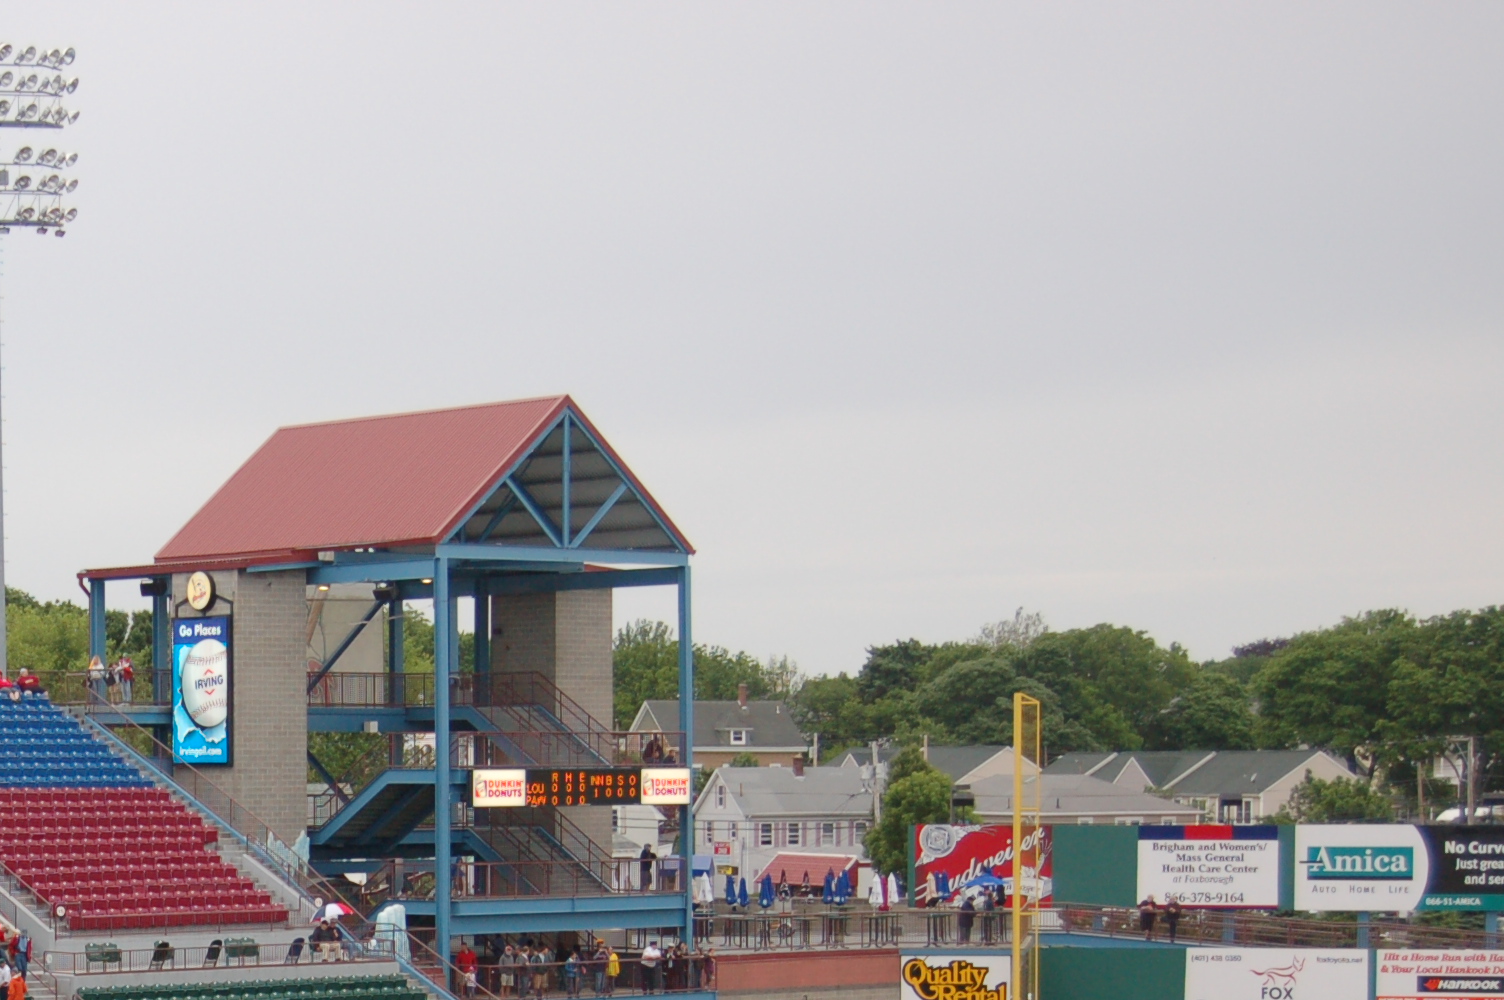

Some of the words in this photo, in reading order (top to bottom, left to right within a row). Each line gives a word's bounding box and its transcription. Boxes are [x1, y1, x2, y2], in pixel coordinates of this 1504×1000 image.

[179, 624, 193, 637] Go
[194, 623, 222, 636] Places
[195, 674, 223, 690] IRVING
[179, 746, 223, 757] irvingoil.com
[552, 772, 559, 783] R
[565, 772, 573, 783] H
[617, 775, 624, 786] S
[526, 783, 545, 794] LOU
[552, 783, 559, 793] 0
[566, 783, 573, 793] 0
[579, 783, 586, 793] 0
[605, 788, 613, 798] 0
[617, 788, 624, 798] 0
[629, 788, 636, 798] 0
[526, 796, 547, 807] PAW
[552, 796, 559, 806] 0
[566, 796, 573, 806] 0
[579, 796, 586, 806] 0
[1152, 842, 1194, 853] Brigham
[1198, 842, 1216, 851] and
[1445, 841, 1466, 854] No
[1468, 841, 1504, 854] Curv
[948, 827, 1045, 893] udweier
[1176, 853, 1202, 862] Mass
[1205, 853, 1244, 862] General
[1309, 846, 1408, 873] Amica
[1162, 864, 1195, 873] Health
[1198, 864, 1221, 873] Care
[1224, 864, 1258, 873] Center
[1455, 858, 1477, 871] Just
[1172, 875, 1181, 883] at
[1464, 873, 1485, 885] and
[1410, 953, 1439, 961] Home
[1445, 966, 1490, 974] Hankook
[1261, 987, 1293, 1000] FOX
